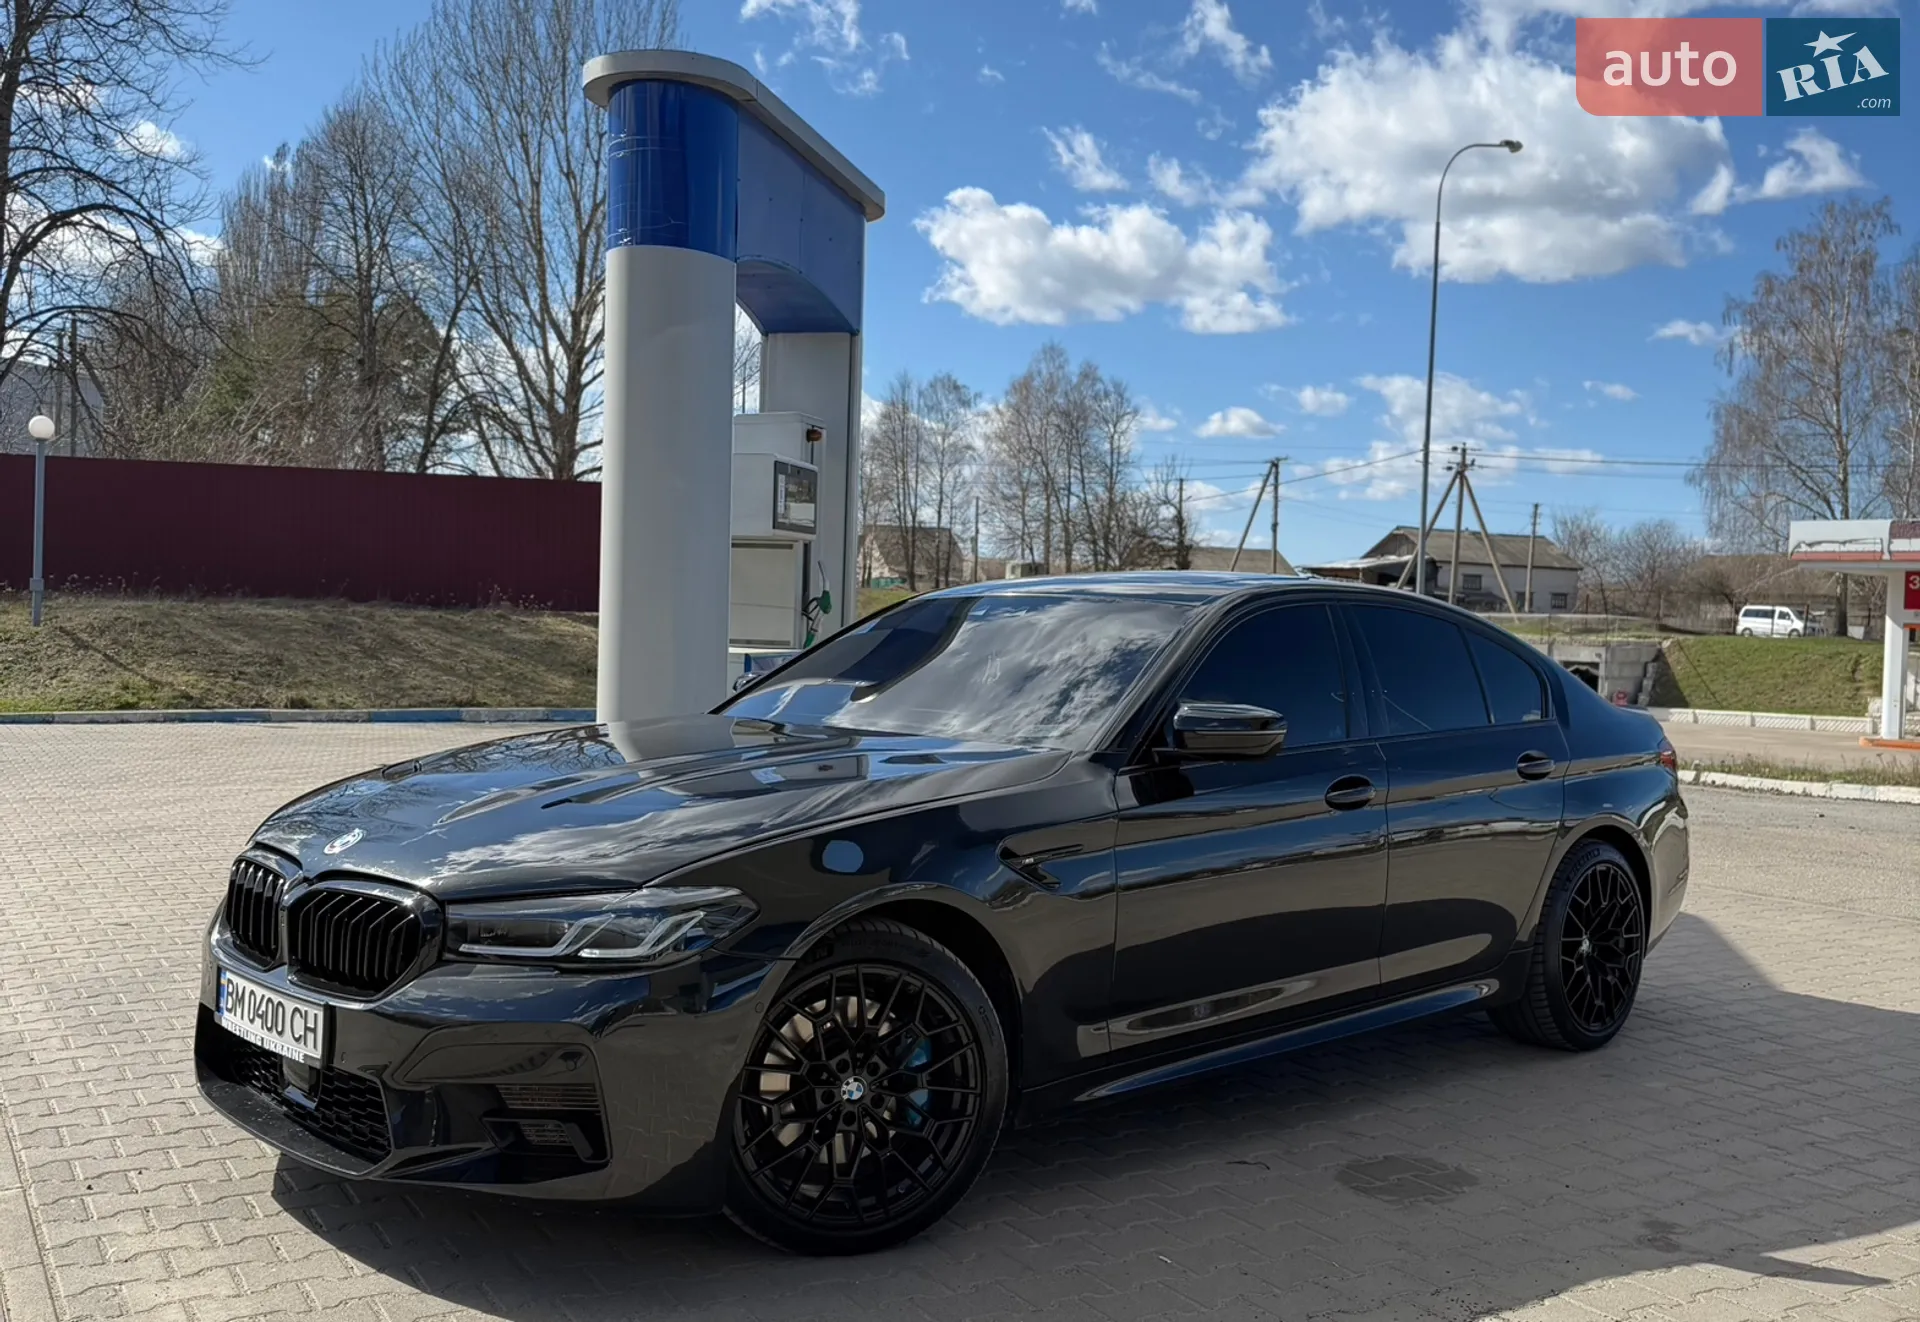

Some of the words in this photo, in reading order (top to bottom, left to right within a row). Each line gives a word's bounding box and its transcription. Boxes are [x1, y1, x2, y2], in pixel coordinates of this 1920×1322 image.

[225, 978, 246, 1021] BM
[248, 989, 286, 1037] 0400
[290, 1006, 319, 1051] CH
[263, 1037, 306, 1064] UKRAINE
